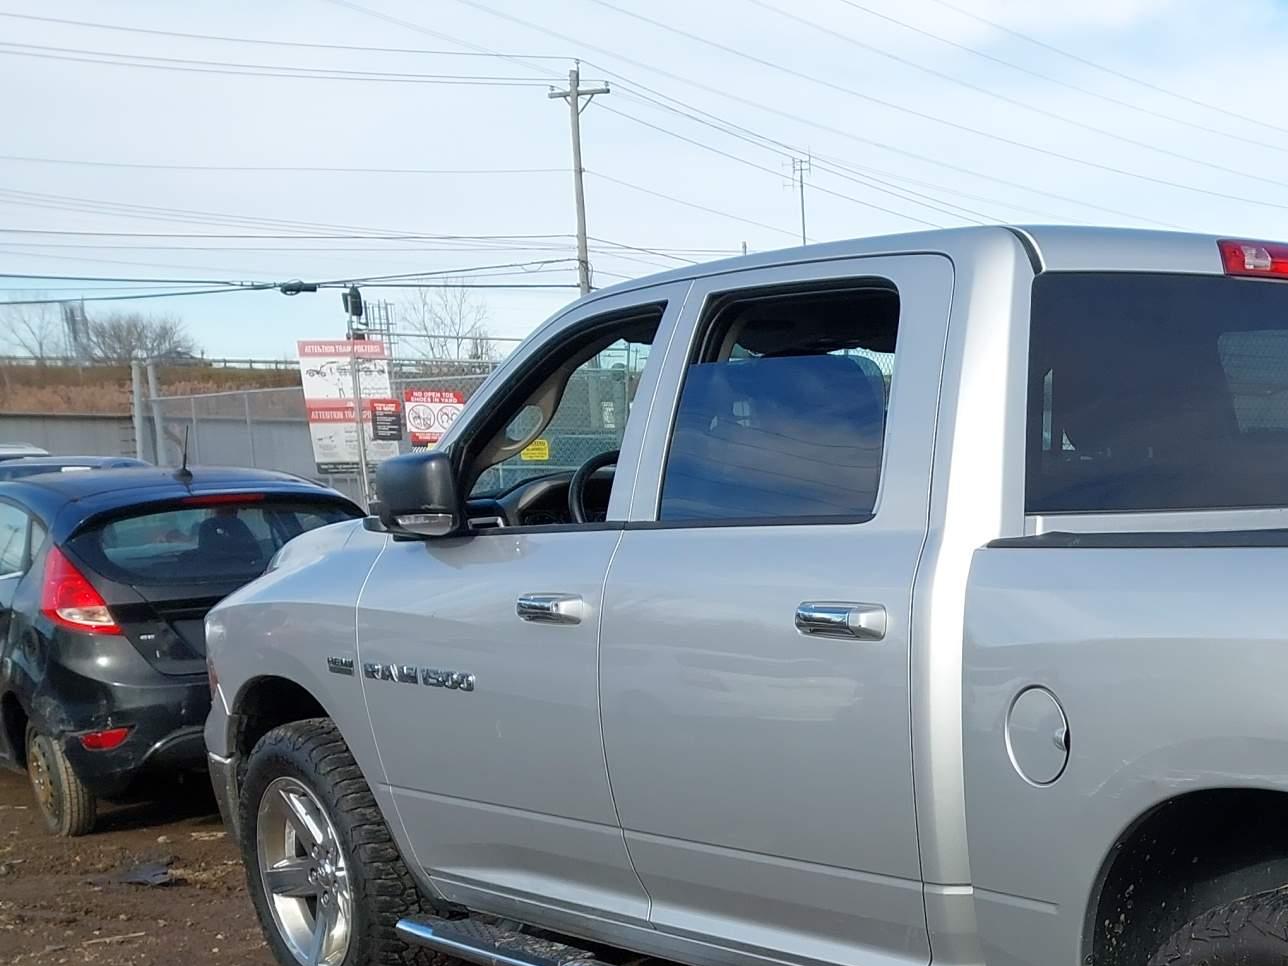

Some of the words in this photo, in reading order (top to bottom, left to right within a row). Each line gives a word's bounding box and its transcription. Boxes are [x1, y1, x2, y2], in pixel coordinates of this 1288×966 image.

[304, 344, 335, 353] ATTENTION
[424, 391, 441, 399] OPEN
[311, 410, 343, 419] ATTENTION
[364, 662, 418, 685] RAM
[420, 667, 476, 692] 1500
